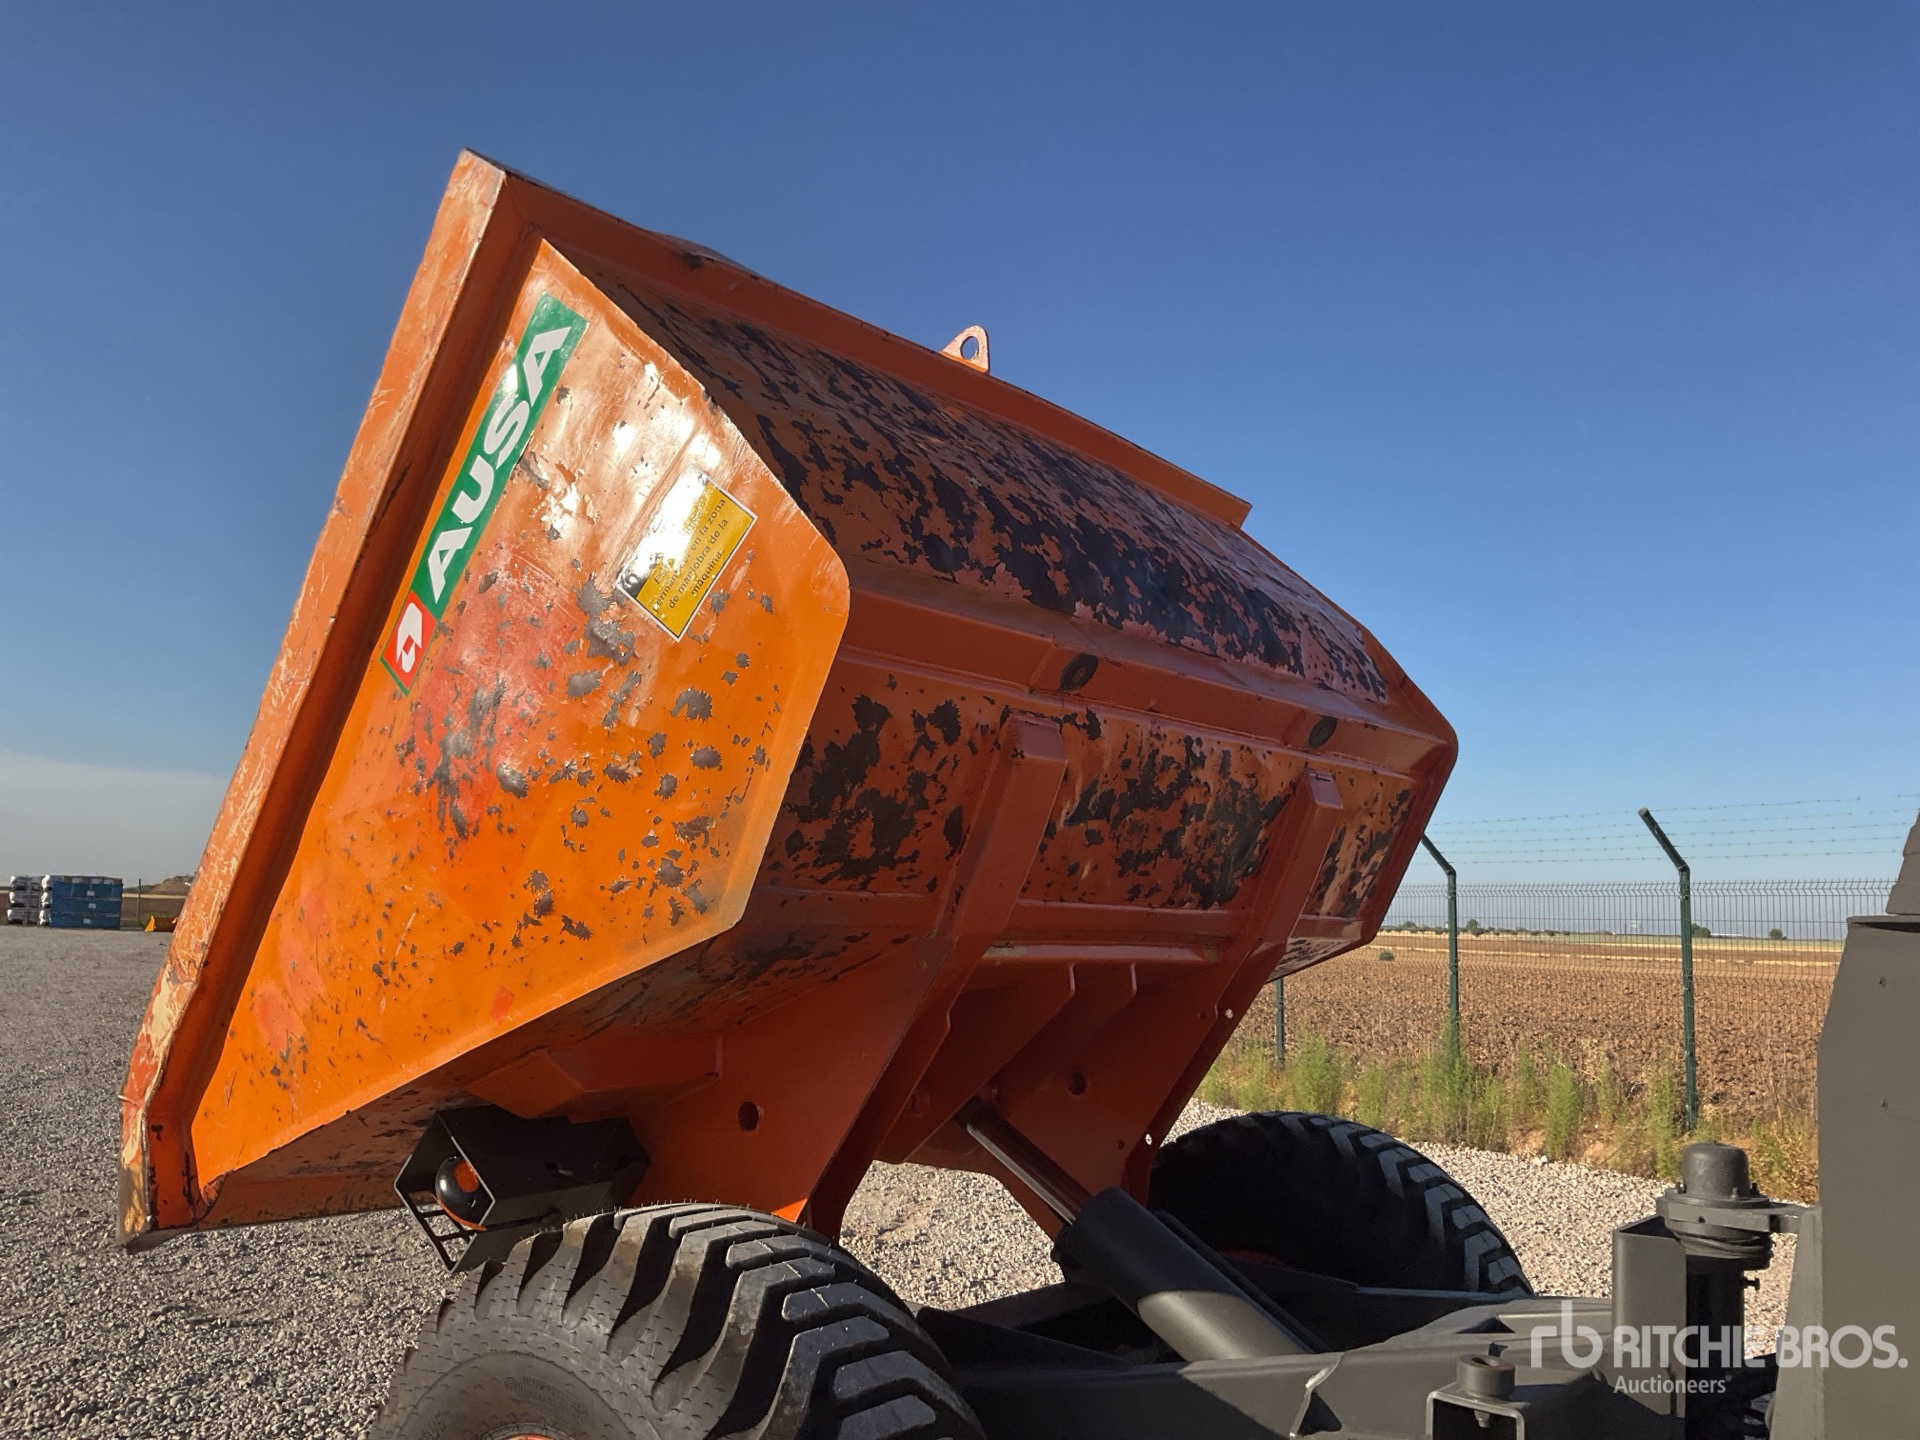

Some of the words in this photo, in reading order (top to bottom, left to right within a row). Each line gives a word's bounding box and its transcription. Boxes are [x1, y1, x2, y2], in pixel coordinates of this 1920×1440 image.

[427, 326, 571, 604] AUSA
[653, 553, 692, 613] permancer
[690, 537, 701, 551] en
[698, 525, 709, 536] la
[707, 498, 726, 525] zona
[669, 595, 679, 609] de
[677, 545, 711, 594] maniobra
[709, 530, 720, 545] de
[717, 518, 729, 530] la
